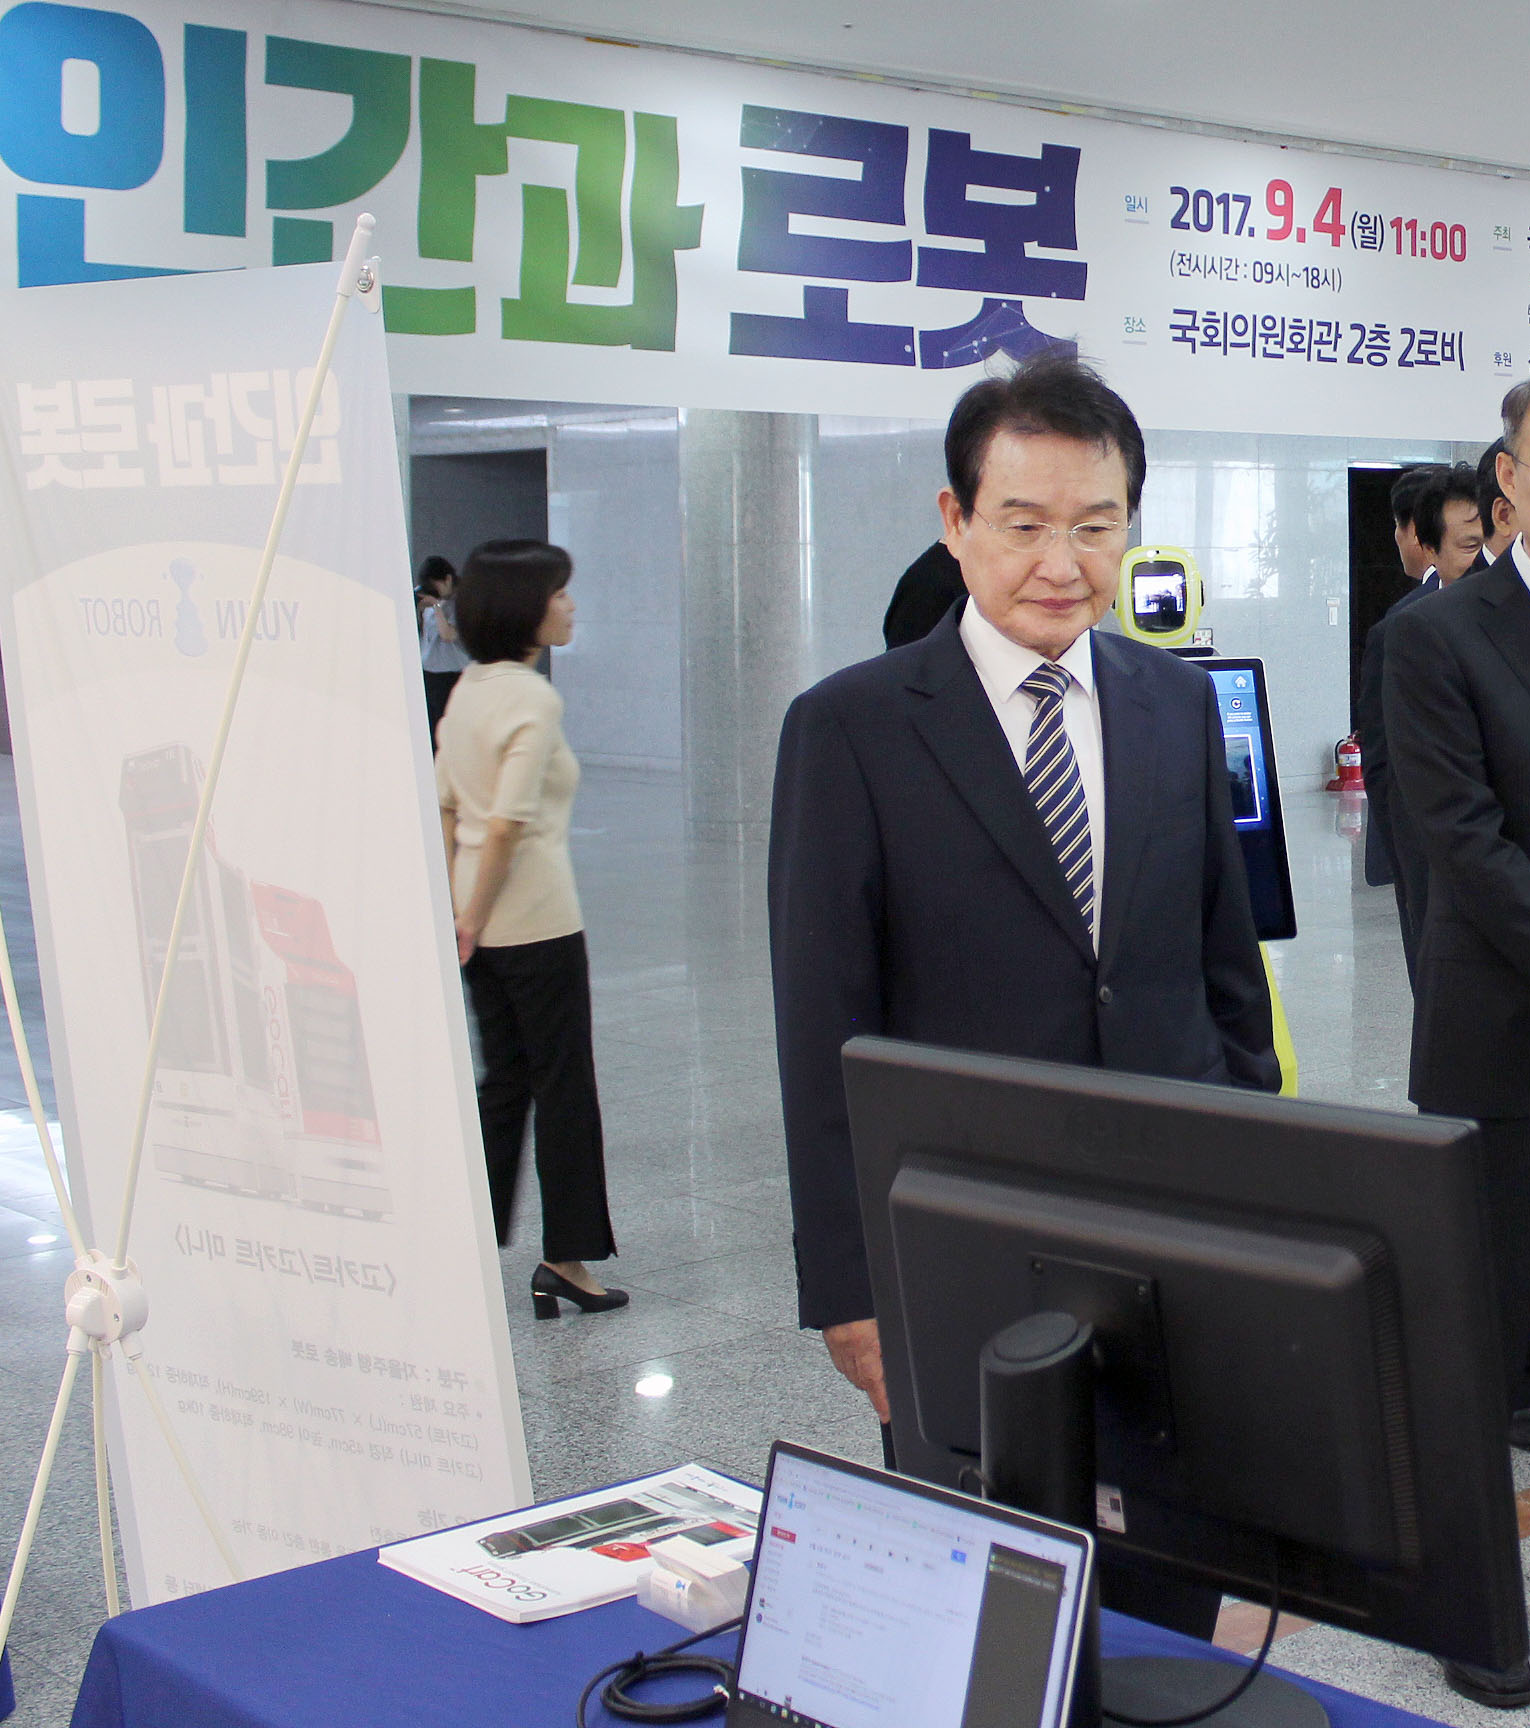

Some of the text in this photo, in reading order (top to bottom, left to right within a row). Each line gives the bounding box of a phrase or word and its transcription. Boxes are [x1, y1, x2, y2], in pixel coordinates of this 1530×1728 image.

[0, 0, 1088, 370] 인간과 로봇
[1124, 195, 1149, 213] 일시
[1169, 185, 1256, 238] 2017.
[1389, 216, 1467, 262] 11:00
[1493, 225, 1511, 242] 주최
[1123, 316, 1147, 334] 장소
[1169, 308, 1465, 371] 국회의원회관 2층 2로비
[1494, 352, 1512, 368] 후원
